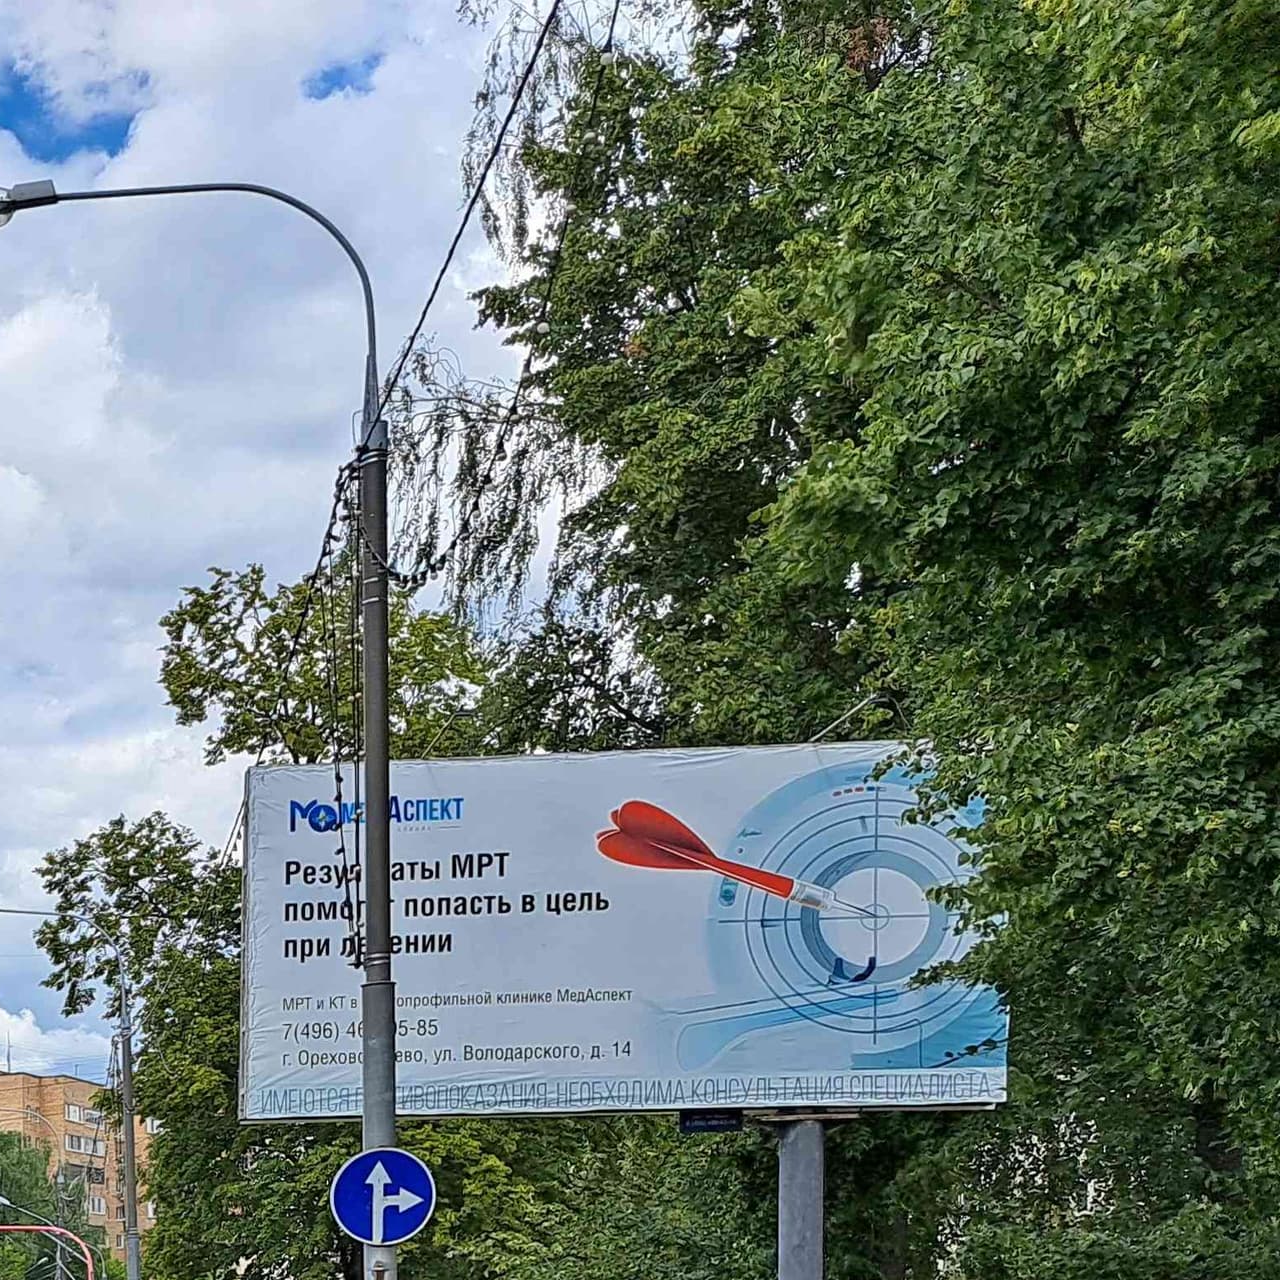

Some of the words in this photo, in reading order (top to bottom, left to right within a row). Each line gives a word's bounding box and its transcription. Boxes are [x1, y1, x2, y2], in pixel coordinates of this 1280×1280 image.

[450, 852, 510, 879] МРТ
[404, 893, 512, 918] попасть
[521, 892, 536, 914] в
[546, 891, 610, 916] цель
[284, 935, 331, 963] при
[282, 996, 313, 1011] МРТ
[316, 998, 325, 1010] и
[329, 996, 347, 1010] КТ
[350, 998, 358, 1009] в
[396, 990, 492, 1010] опрофильной
[496, 991, 552, 1005] клинике
[557, 988, 634, 1005] МедАспект
[282, 1021, 340, 1043] 7(496)
[282, 1053, 292, 1067] г.
[433, 1047, 457, 1067] ул.
[463, 1043, 585, 1064] Володарского,
[590, 1045, 605, 1060] д.
[612, 1041, 632, 1057] 14
[260, 1086, 352, 1114] ИМЕЮТСЯ
[556, 1078, 685, 1110] НЕОБХОДИМА
[692, 1075, 844, 1105] КОНСУЛЬТАЦИЯ
[849, 1073, 991, 1103] СПЕЦИАЛИСТА
